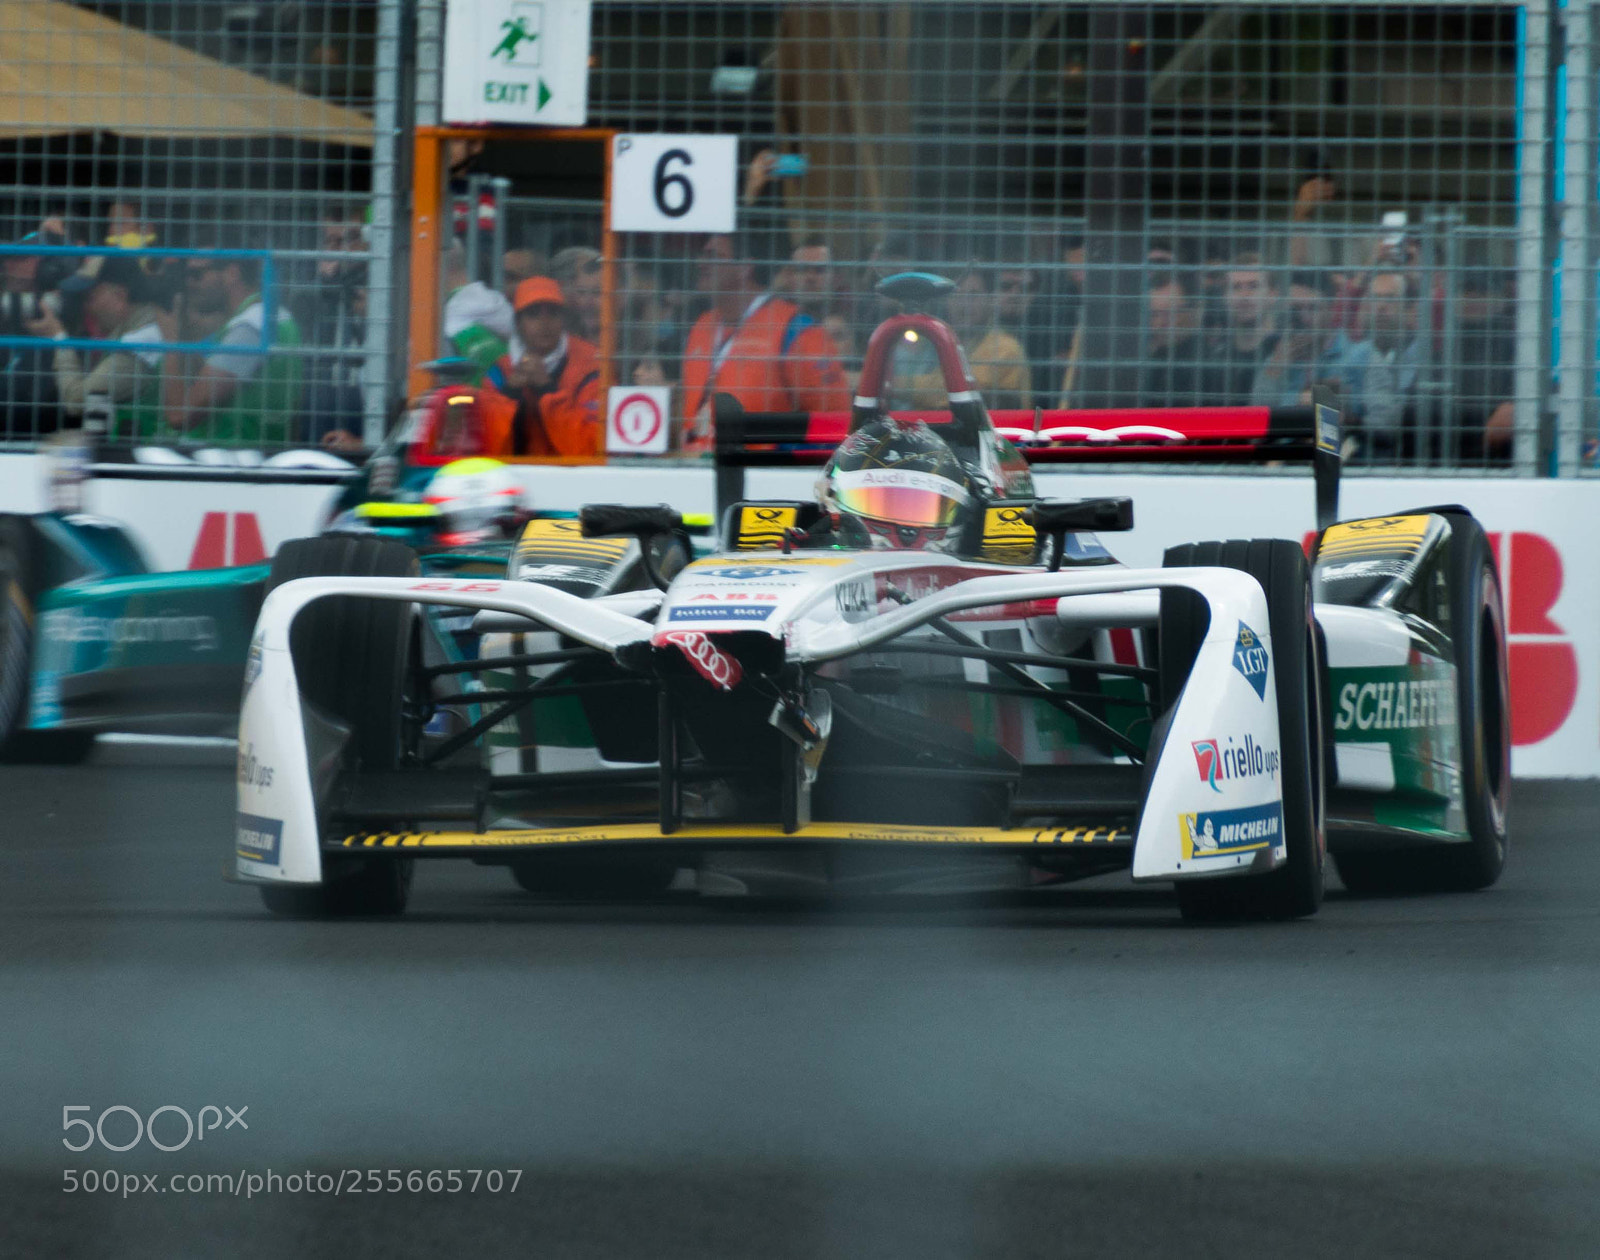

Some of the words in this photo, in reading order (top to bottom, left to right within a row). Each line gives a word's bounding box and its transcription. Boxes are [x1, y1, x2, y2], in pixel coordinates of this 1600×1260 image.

[484, 81, 529, 103] EXIT
[617, 138, 632, 156] P
[653, 148, 695, 219] 6
[862, 471, 905, 484] Audi
[1236, 648, 1267, 676] LGT
[1334, 680, 1457, 731] SCHAEFF
[1223, 733, 1263, 780] riello
[1265, 749, 1280, 781] ups
[1219, 816, 1279, 844] MICHELIN
